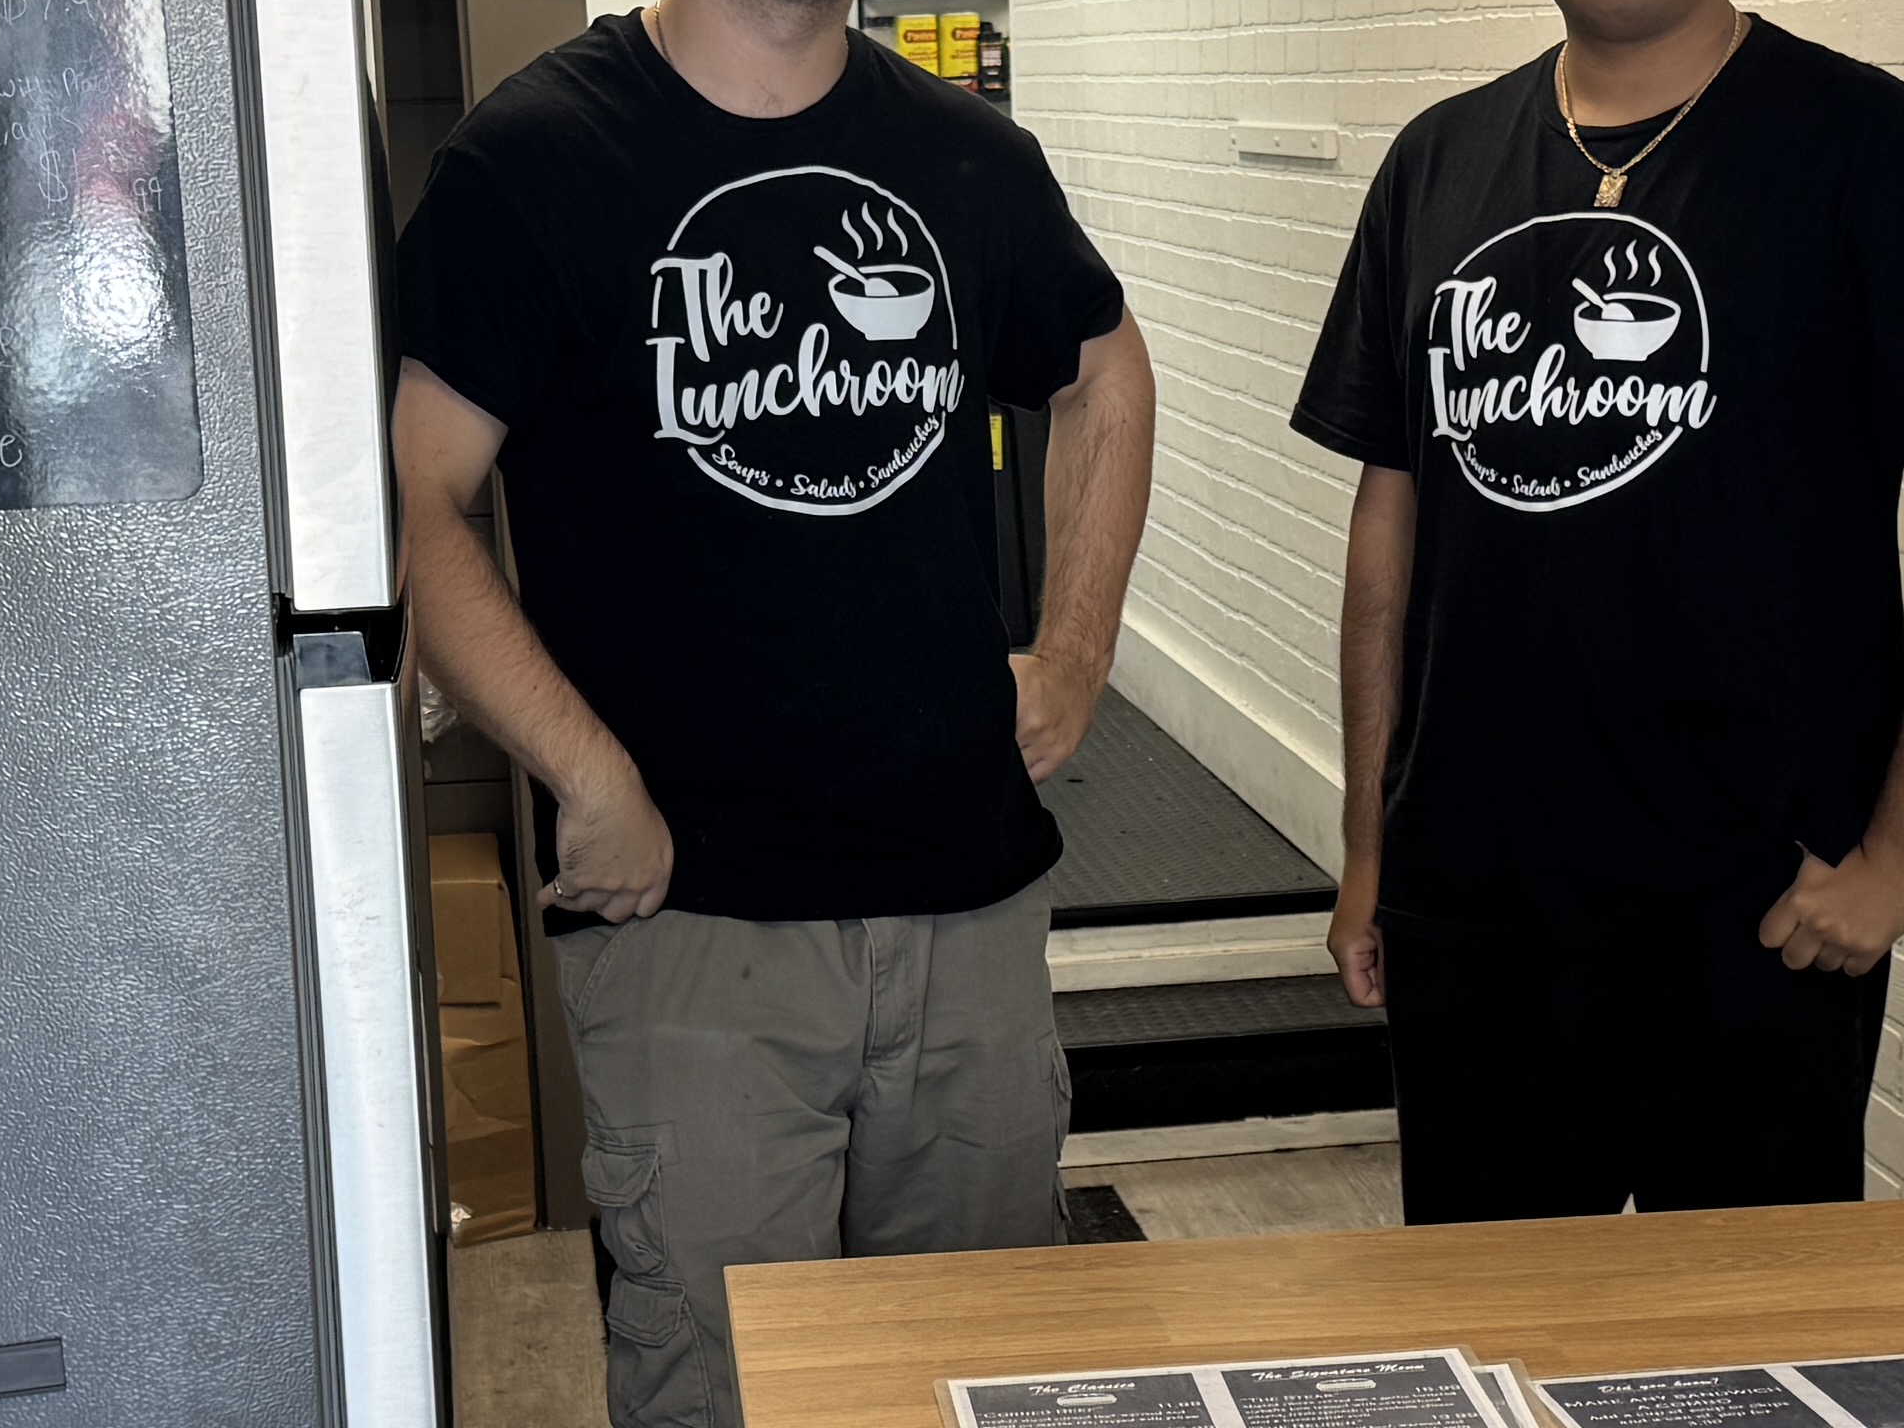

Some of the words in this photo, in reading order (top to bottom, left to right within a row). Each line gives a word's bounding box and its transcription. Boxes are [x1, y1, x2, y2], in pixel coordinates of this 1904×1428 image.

[650, 252, 784, 362] The
[1434, 276, 1532, 371] The
[645, 323, 965, 445] Lunchroom
[1427, 343, 1718, 442] Lunchroom
[712, 443, 770, 487] Soups
[789, 473, 857, 499] Salads
[866, 413, 940, 489] Sandwiches
[1463, 442, 1498, 483] Soups
[1511, 475, 1560, 497] Salads
[1577, 428, 1663, 488] Sandwiches
[1029, 1385, 1060, 1396] The
[1067, 1382, 1136, 1394] Classics
[1251, 1371, 1283, 1381] The
[1290, 1367, 1371, 1379] Signature
[1564, 1398, 1624, 1408] MAKE
[1629, 1395, 1666, 1403] ANY
[1673, 1387, 1782, 1400] SANDWICH
[1598, 1384, 1636, 1394] Did
[1639, 1382, 1666, 1391] you
